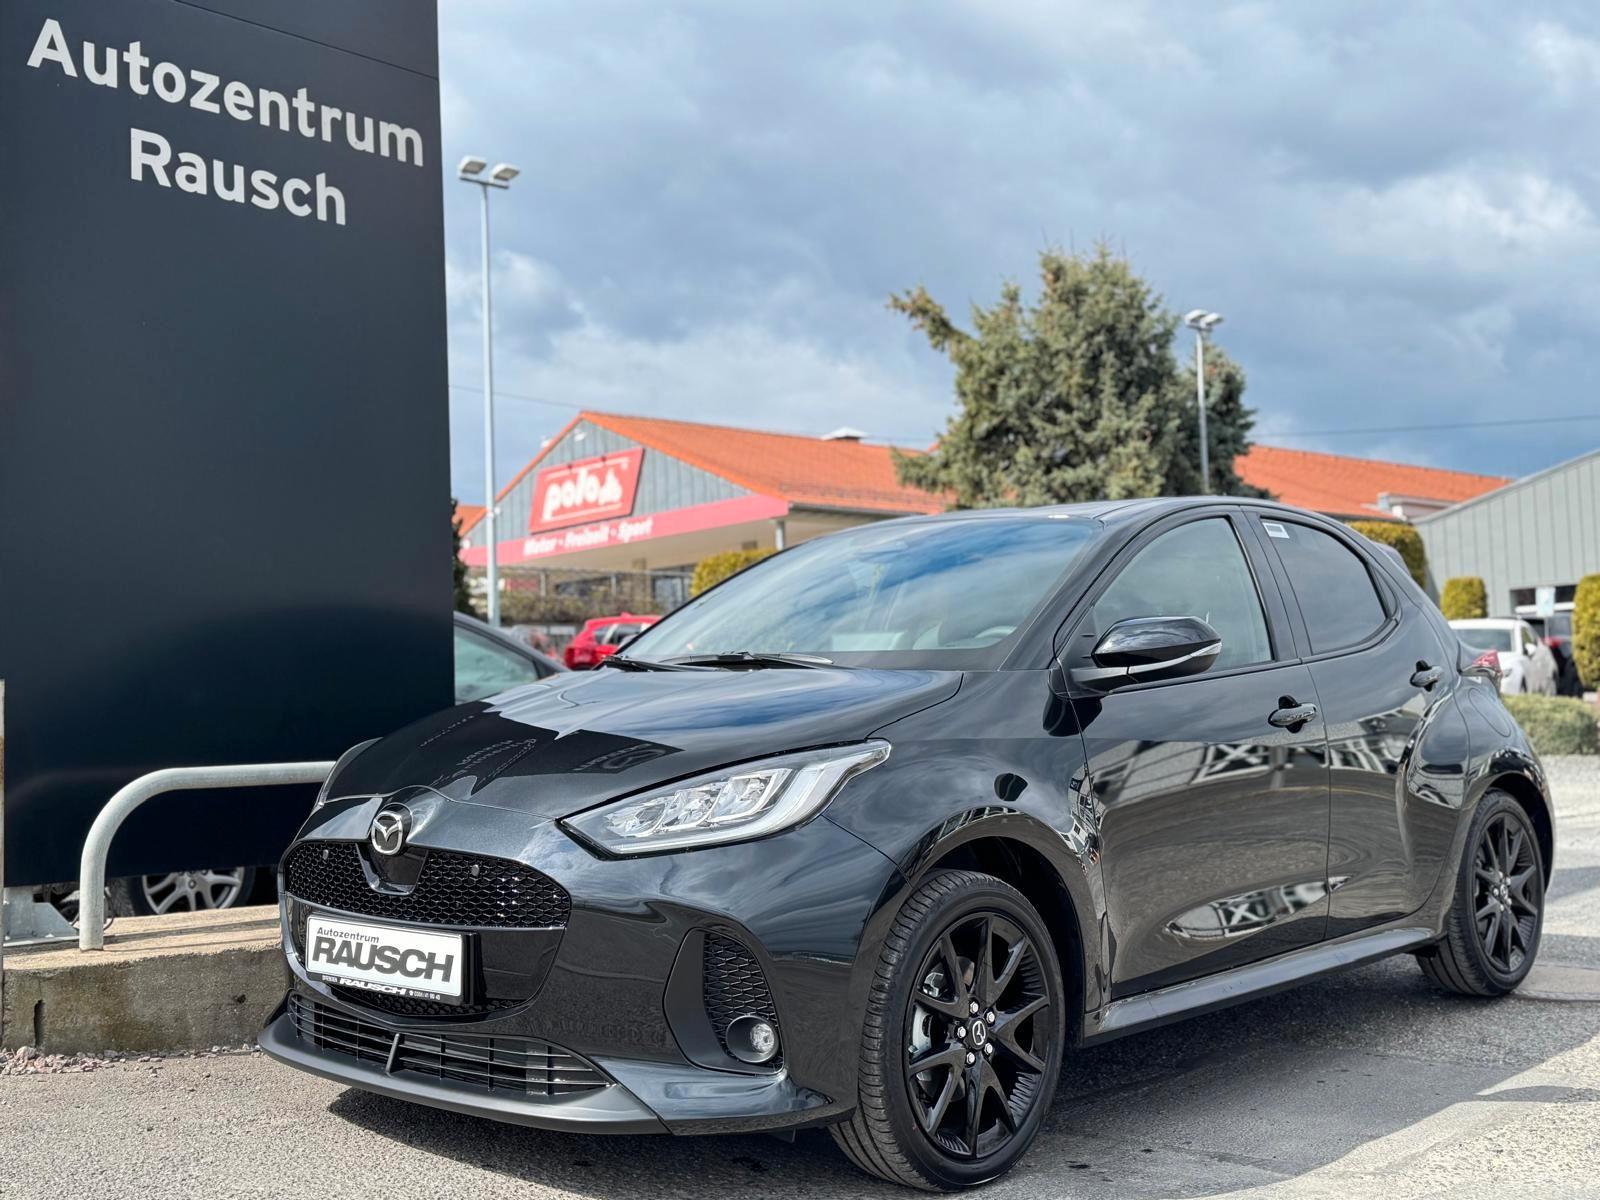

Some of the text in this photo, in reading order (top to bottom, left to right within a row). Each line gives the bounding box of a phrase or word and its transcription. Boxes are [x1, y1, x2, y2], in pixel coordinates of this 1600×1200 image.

[26, 18, 424, 167] Autozentrum
[130, 127, 347, 226] Rausch
[542, 467, 601, 521] polo
[312, 936, 454, 983] RAUSCH
[317, 927, 379, 943] Autozentrum
[340, 977, 407, 995] RAUSCH
